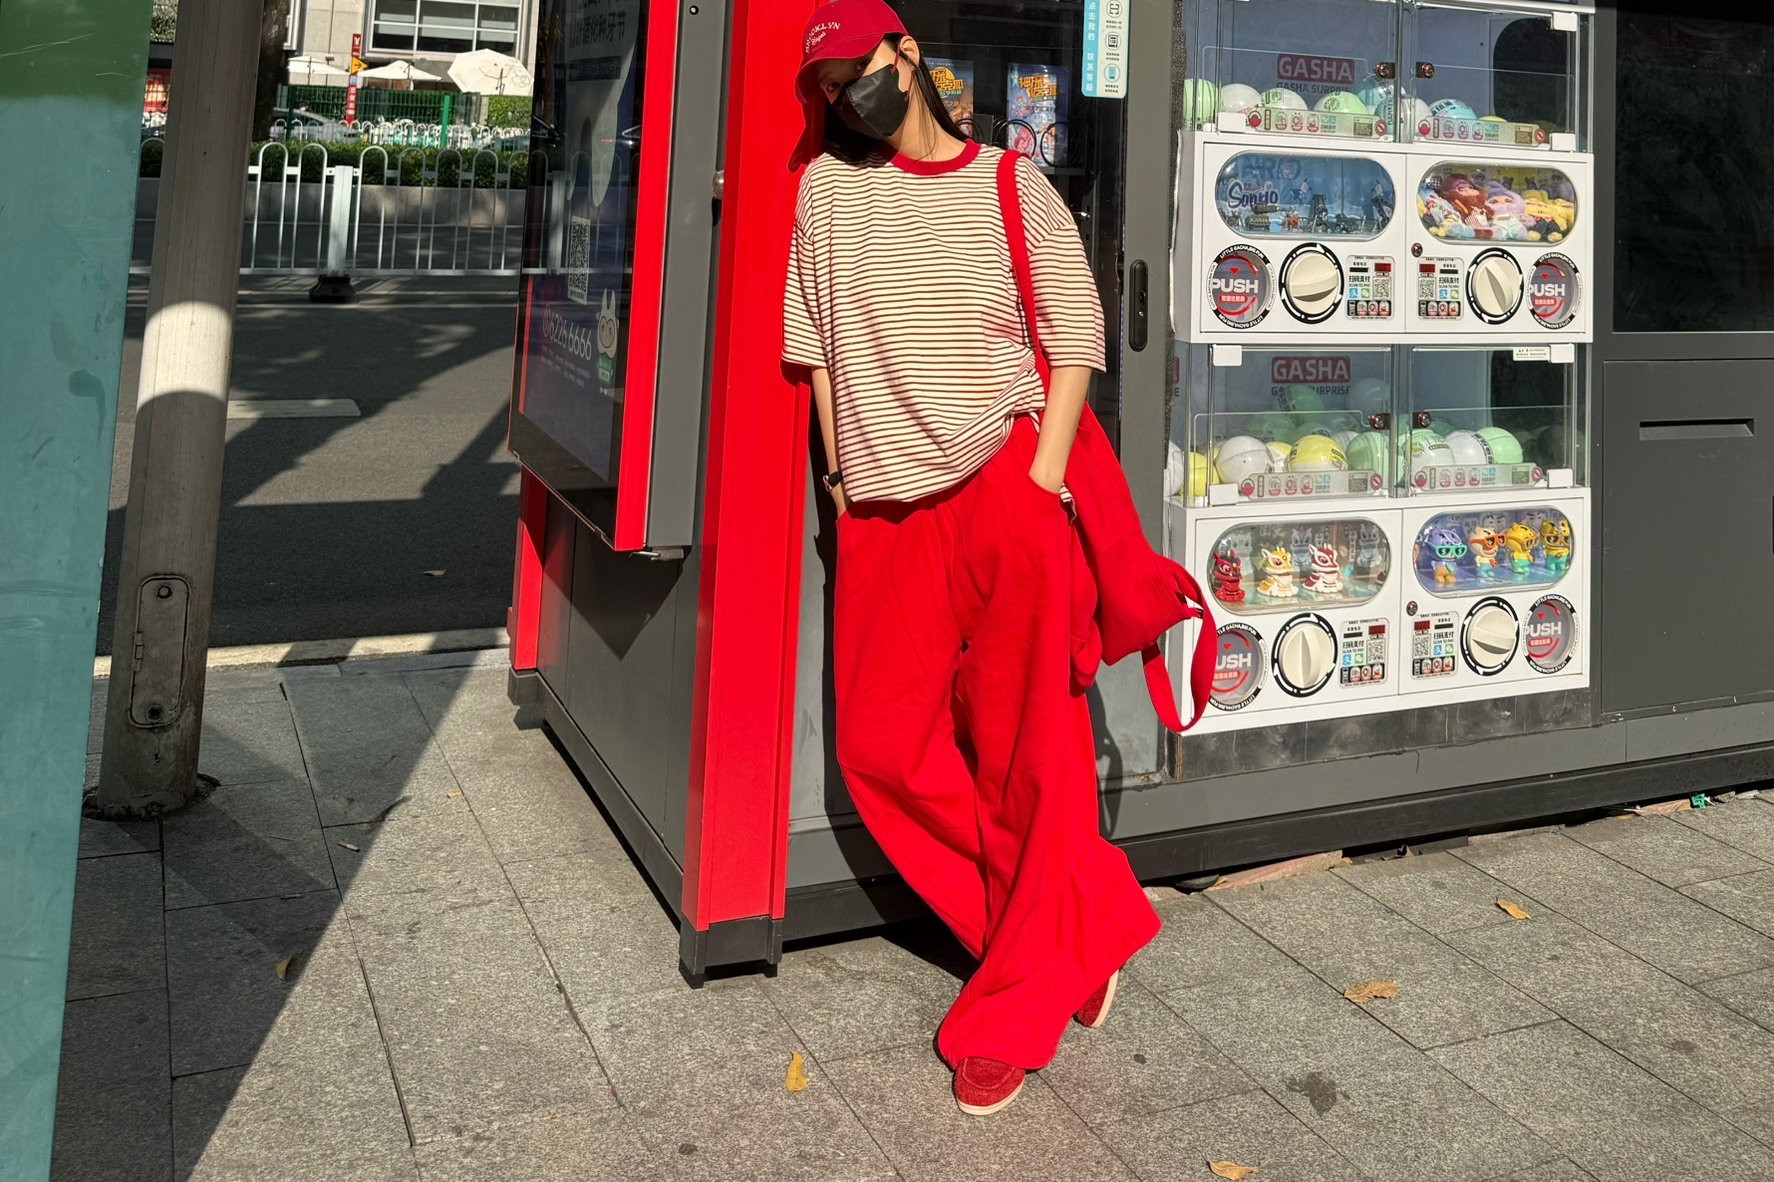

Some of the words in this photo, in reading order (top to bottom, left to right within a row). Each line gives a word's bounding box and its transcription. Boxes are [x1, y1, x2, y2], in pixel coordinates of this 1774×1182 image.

[1278, 55, 1353, 81] GASHA
[1211, 278, 1259, 293] PUSH
[549, 312, 568, 348] 6226
[568, 322, 593, 361] 6666
[1273, 359, 1350, 381] GASHA
[1217, 652, 1252, 670] USH
